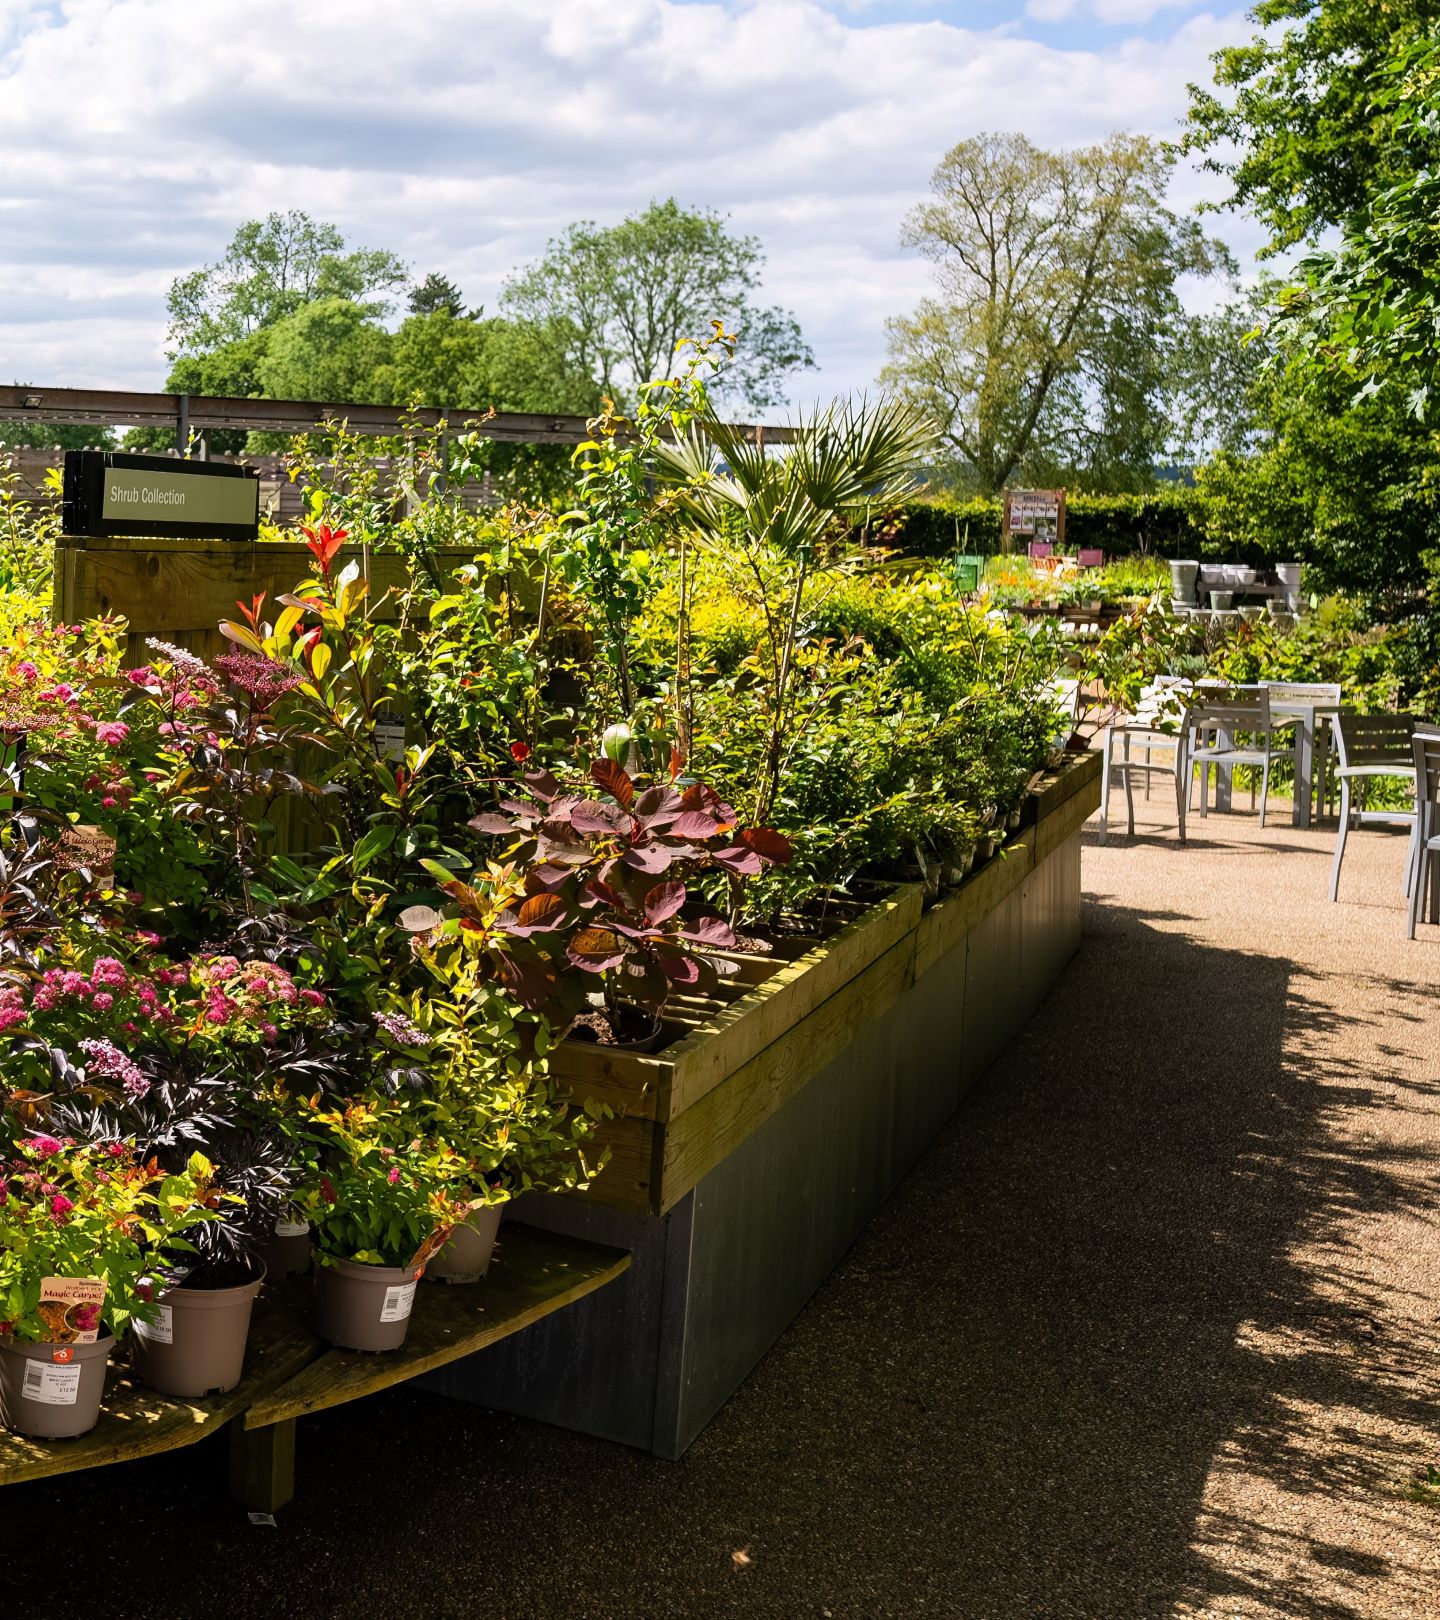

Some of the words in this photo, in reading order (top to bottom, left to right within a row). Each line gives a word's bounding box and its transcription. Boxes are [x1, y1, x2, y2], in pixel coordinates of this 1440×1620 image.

[110, 485, 139, 503] Shrub
[141, 487, 185, 505] Collection
[44, 1290, 71, 1299] Magic
[72, 1290, 102, 1300] Carpet
